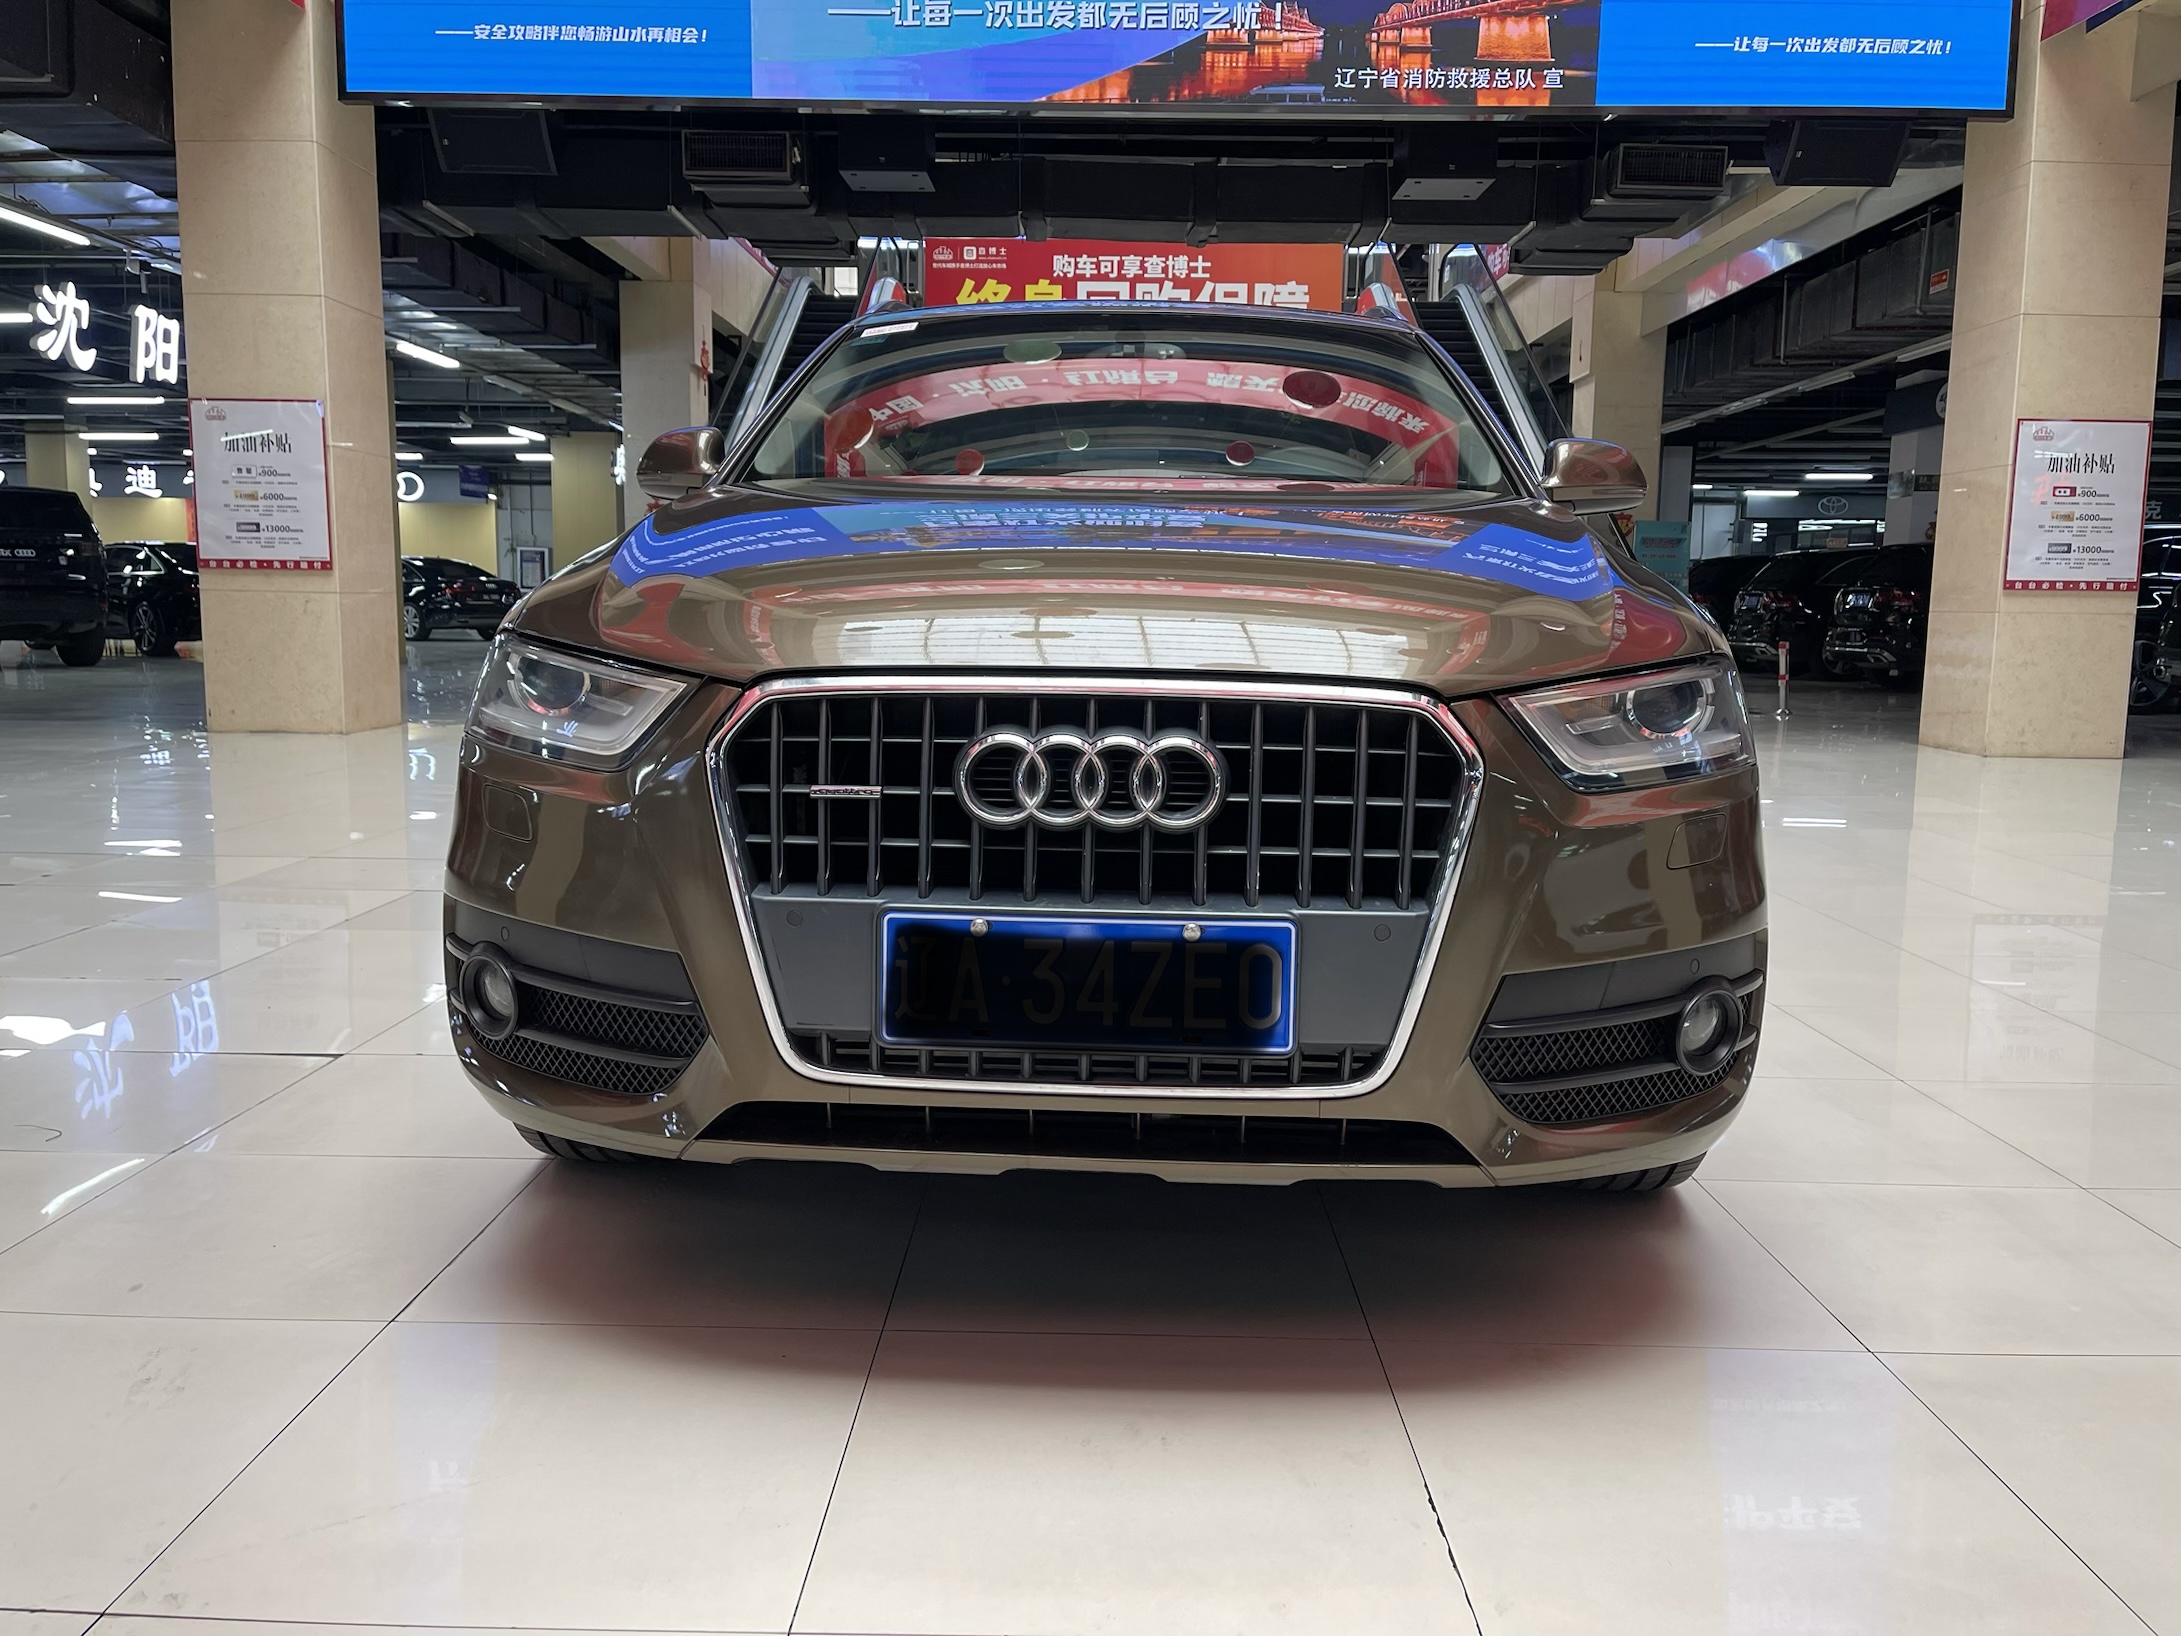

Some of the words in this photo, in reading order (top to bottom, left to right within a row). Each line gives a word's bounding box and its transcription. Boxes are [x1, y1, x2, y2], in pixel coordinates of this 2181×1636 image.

[1334, 68, 1536, 90] 辽宁省消防救援总队
[1542, 69, 1565, 90] 宣
[1052, 254, 1212, 278] 购车可享查博士
[30, 281, 180, 384] 沈阳
[224, 432, 292, 453] 加油补贴
[2047, 453, 2115, 474] 加油补贴
